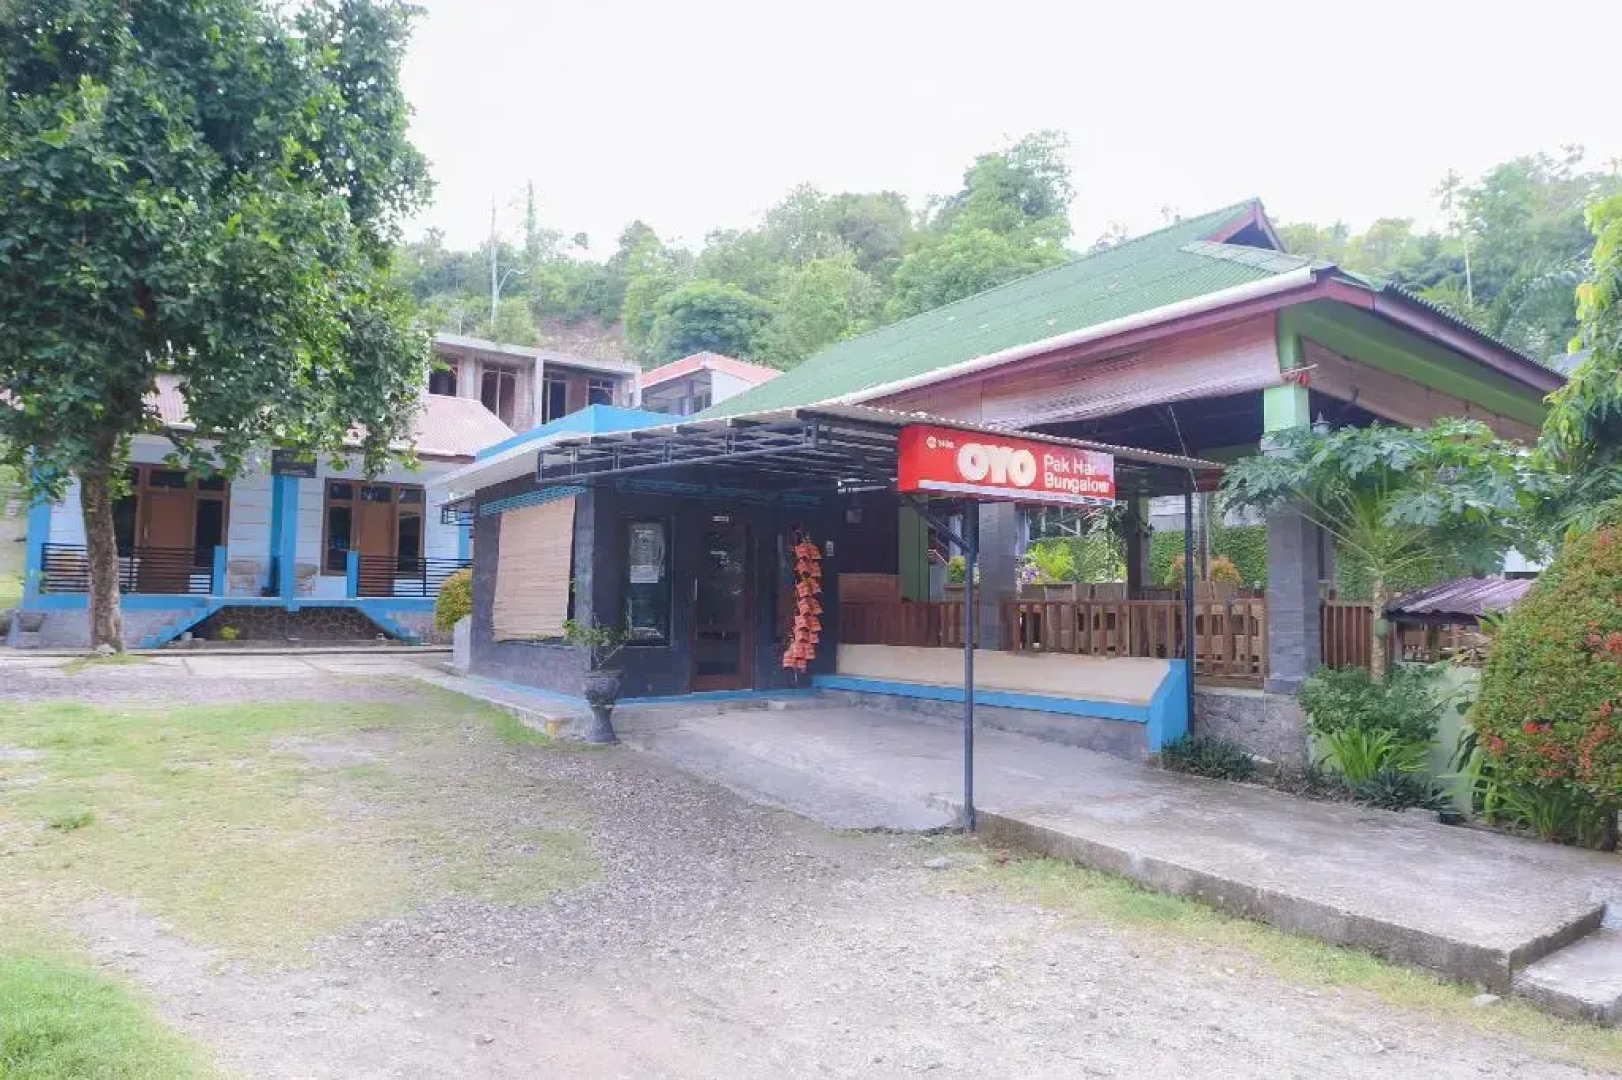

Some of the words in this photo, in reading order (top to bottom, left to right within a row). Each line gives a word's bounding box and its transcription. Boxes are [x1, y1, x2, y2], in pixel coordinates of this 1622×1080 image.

[958, 443, 1036, 487] OYO
[1044, 454, 1069, 473] Pak
[1044, 472, 1110, 493] Bungalow
